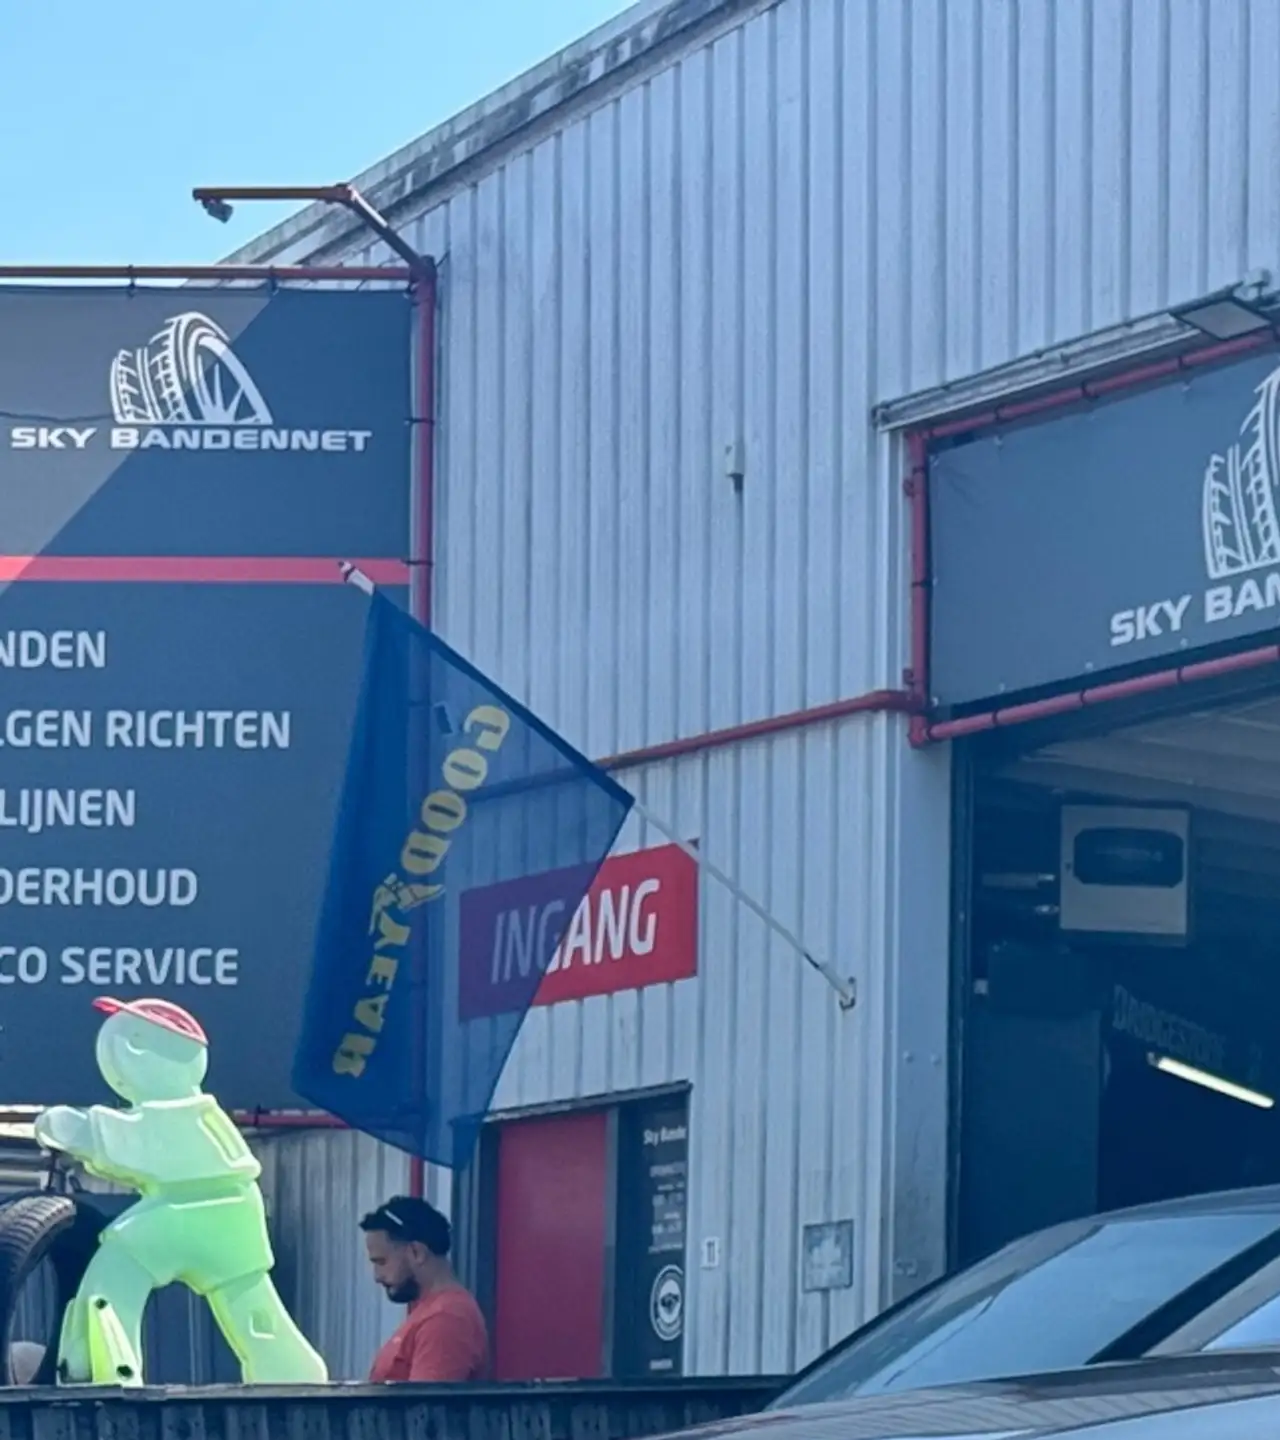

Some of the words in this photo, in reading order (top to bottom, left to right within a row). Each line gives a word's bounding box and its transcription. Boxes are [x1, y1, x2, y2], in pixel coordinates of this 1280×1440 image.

[10, 427, 97, 449] SKY
[111, 427, 372, 451] BANDENNET
[1109, 594, 1192, 647] SKY
[0, 710, 91, 747] GEN
[106, 710, 290, 749] RICHTEN
[0, 788, 135, 833] LIJNEN
[491, 877, 661, 985] INGANG
[60, 947, 239, 985] SERVICE
